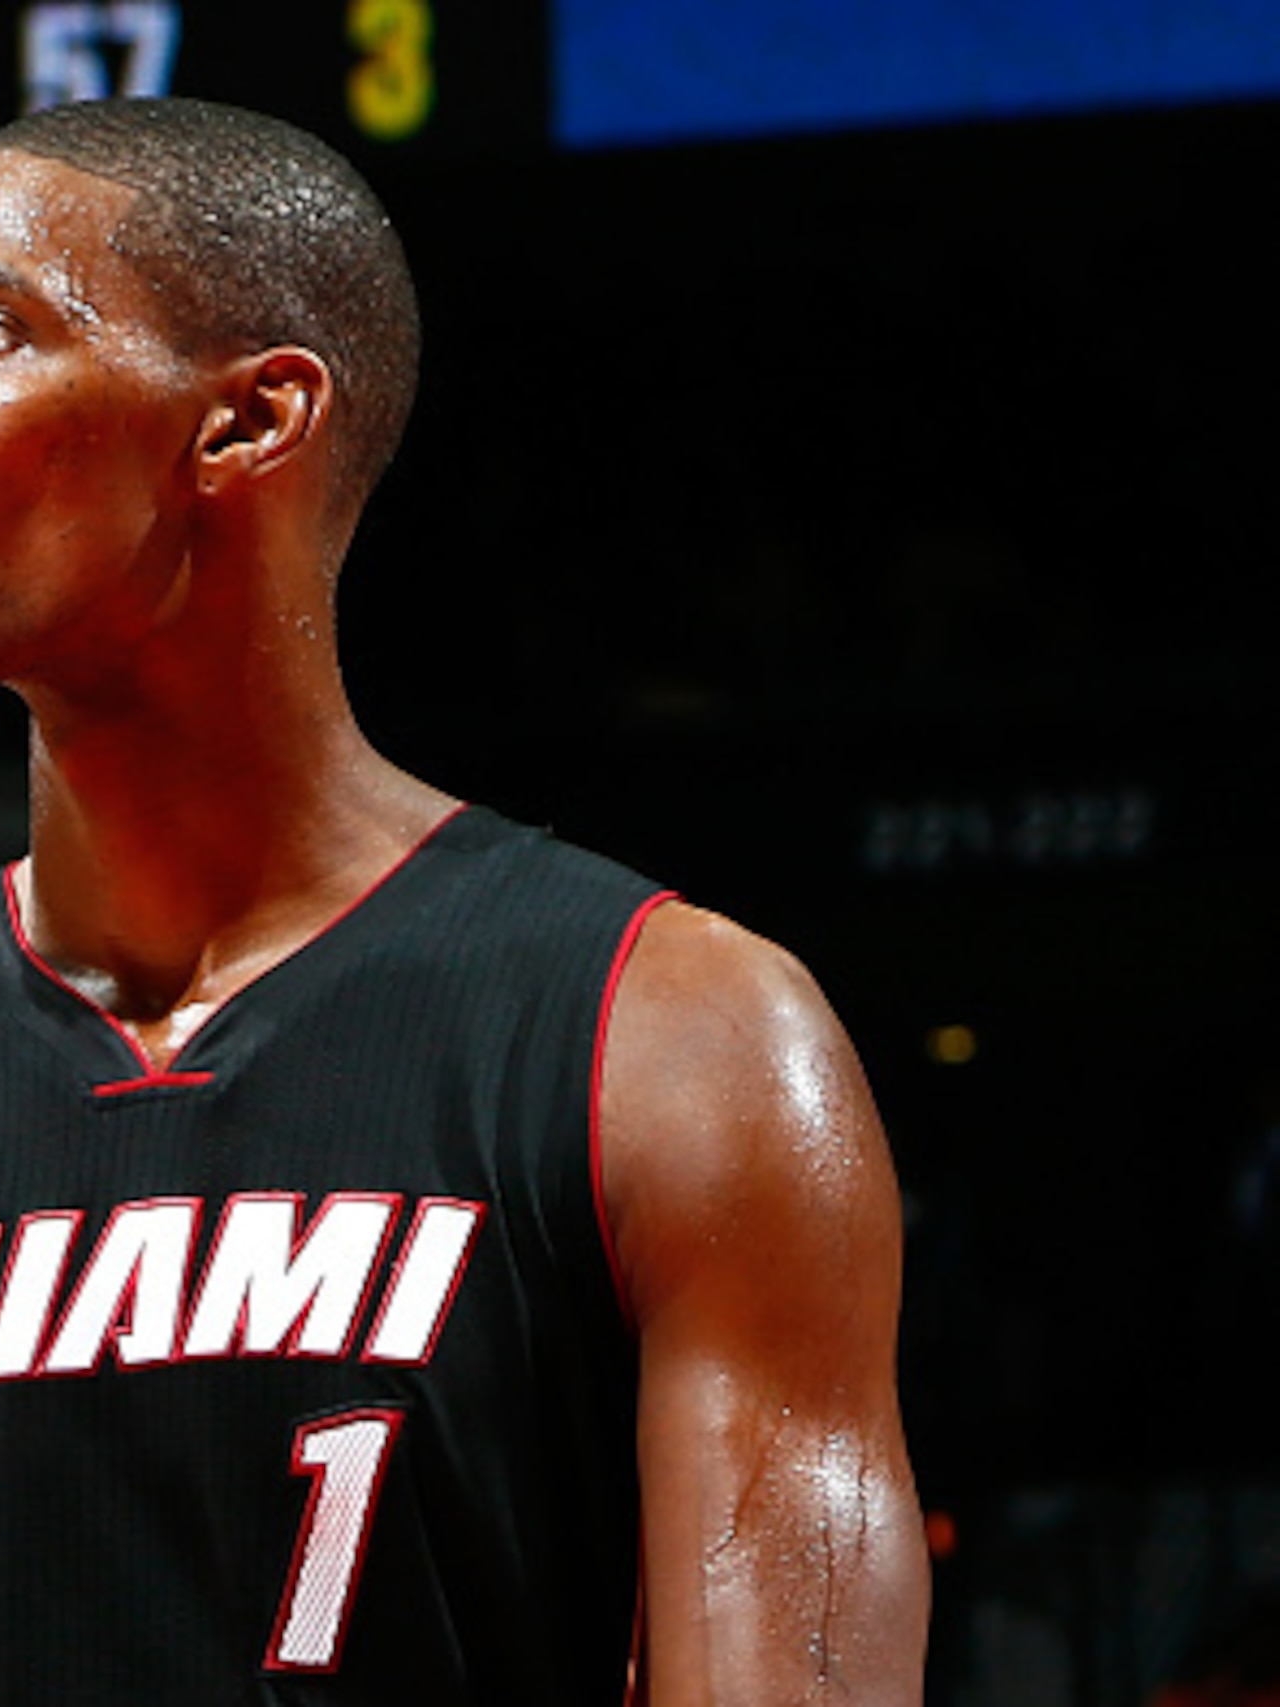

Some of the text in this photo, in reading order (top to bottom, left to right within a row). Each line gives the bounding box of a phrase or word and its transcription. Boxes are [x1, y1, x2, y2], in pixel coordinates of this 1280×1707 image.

[24, 2, 180, 112] 57
[347, 0, 432, 138] 3
[263, 1407, 406, 1674] 1
